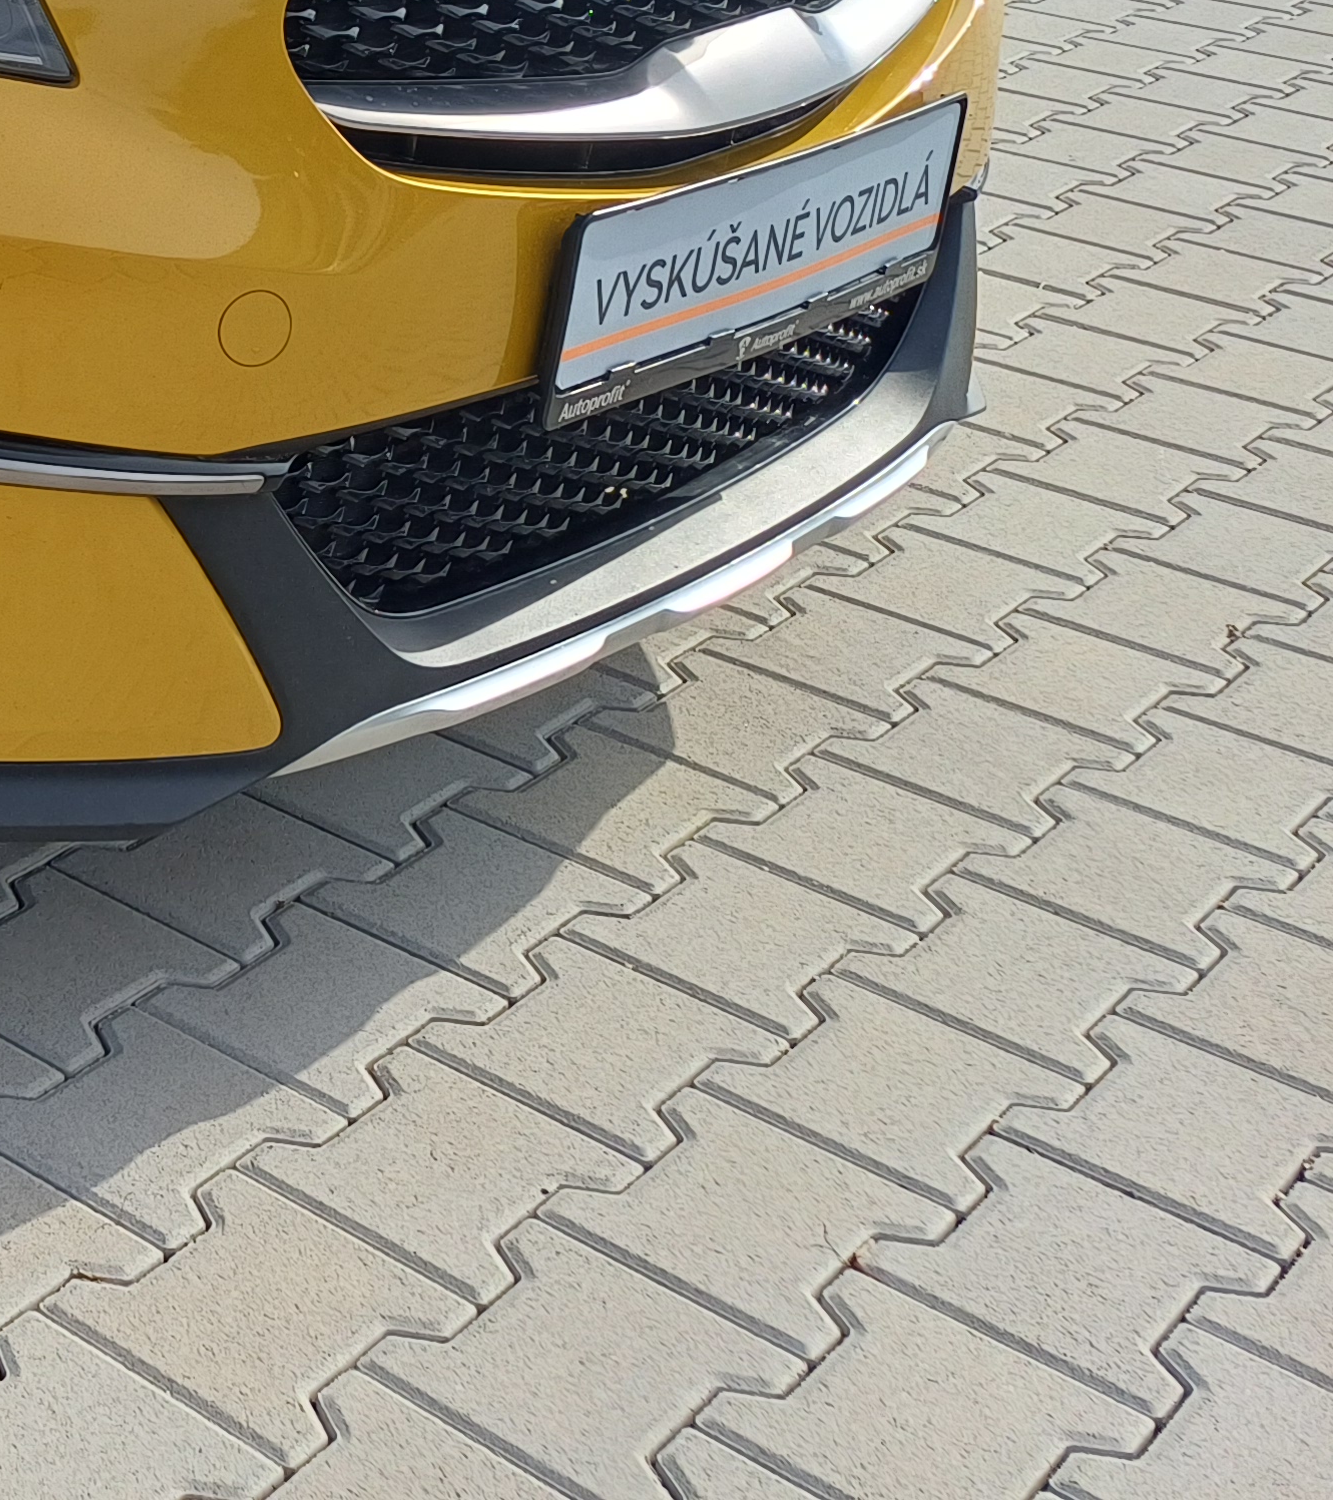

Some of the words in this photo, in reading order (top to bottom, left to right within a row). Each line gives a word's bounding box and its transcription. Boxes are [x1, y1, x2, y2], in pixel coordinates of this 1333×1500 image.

[596, 198, 810, 325] VYSKÚŠANÉ
[815, 150, 933, 251] VOZIDLÁ
[849, 260, 928, 309] www.autoprofit.sk
[558, 385, 626, 423] Autoprofit
